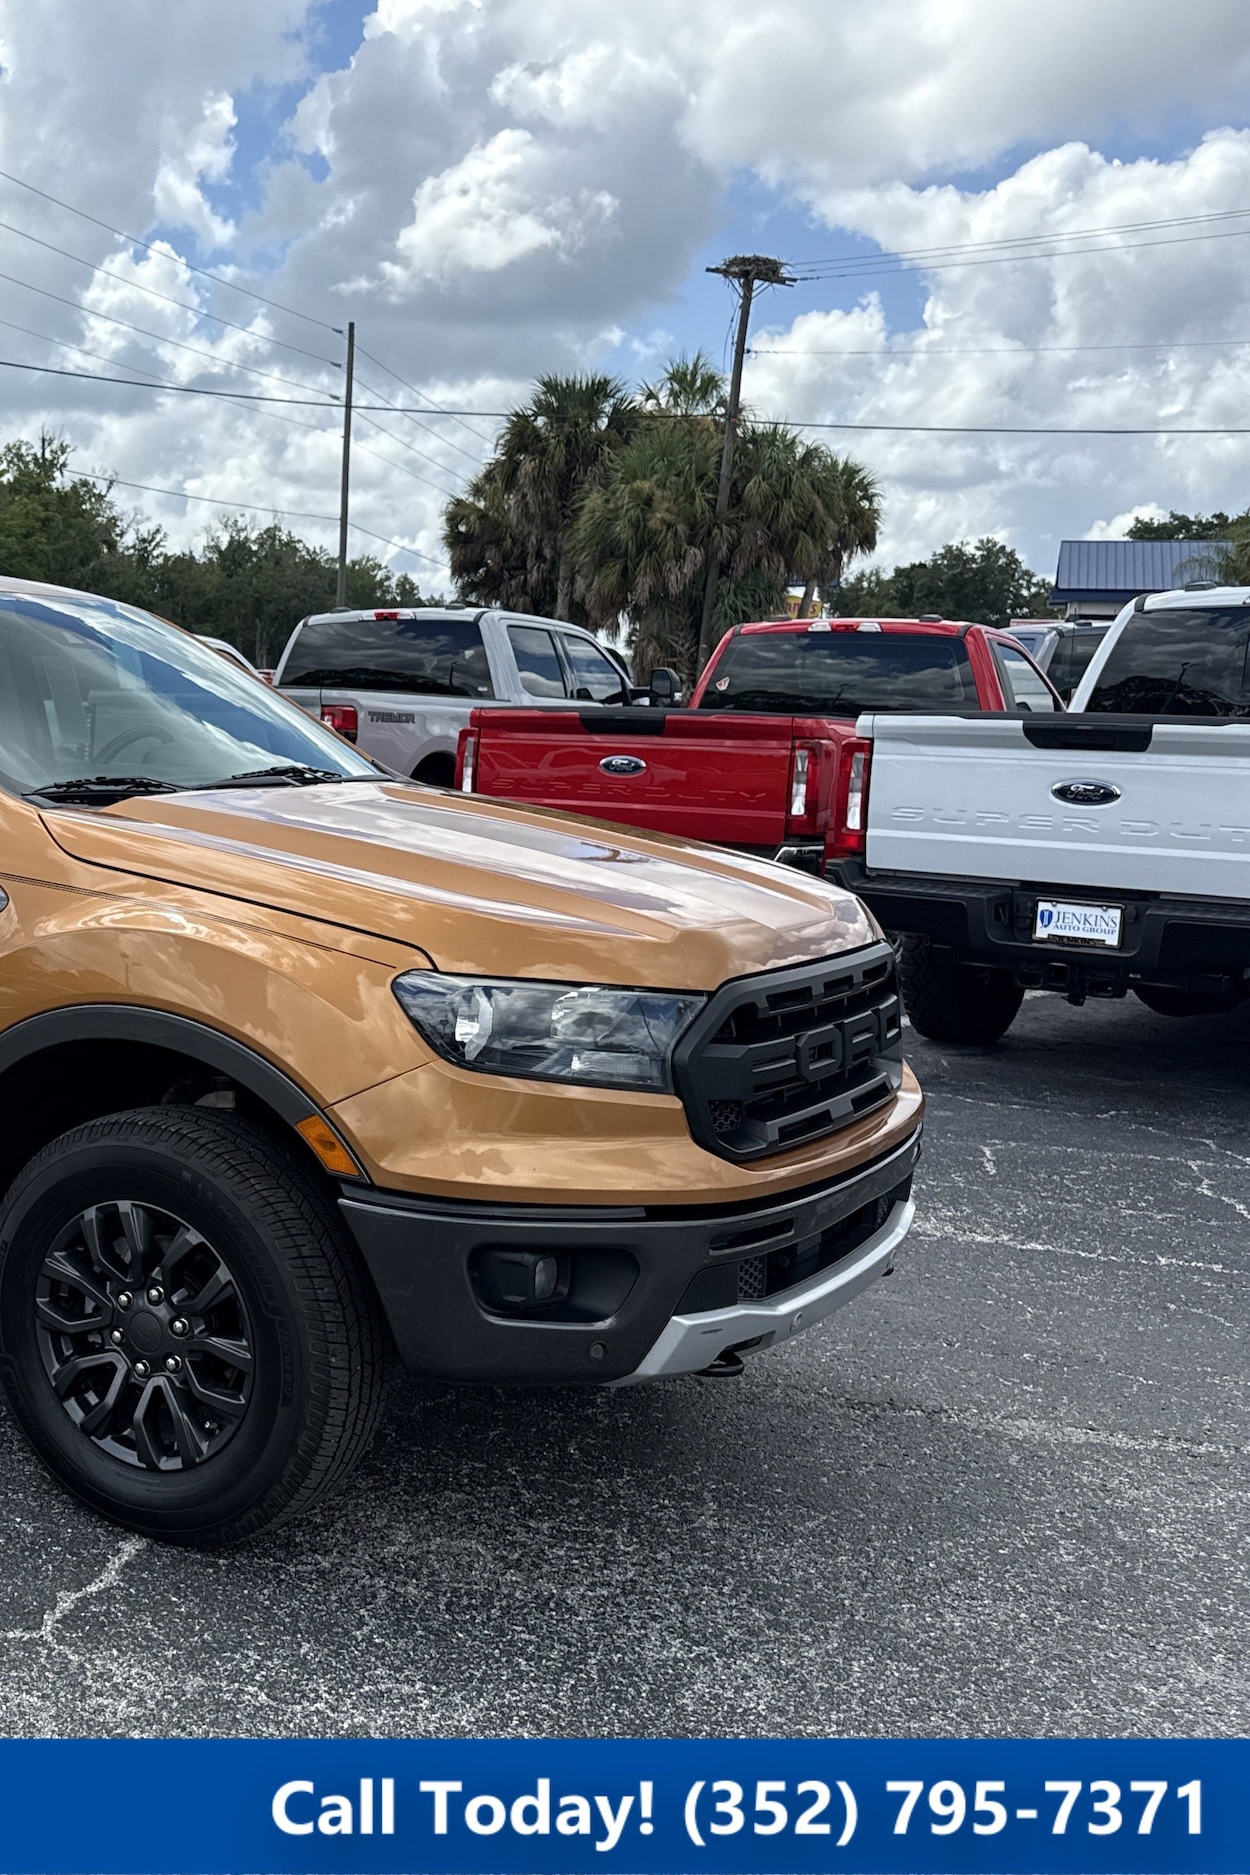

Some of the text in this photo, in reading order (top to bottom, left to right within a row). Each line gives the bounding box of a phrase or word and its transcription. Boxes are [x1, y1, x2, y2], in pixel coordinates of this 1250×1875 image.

[368, 711, 415, 724] TREMOR
[609, 758, 635, 771] Ford
[492, 778, 767, 802] SUPER DUTY
[1066, 784, 1105, 801] Ford
[891, 806, 1100, 833] SUPER
[1053, 910, 1118, 928] JENKINS
[1053, 923, 1117, 935] AUTO GROUP
[740, 1000, 902, 1098] FORD
